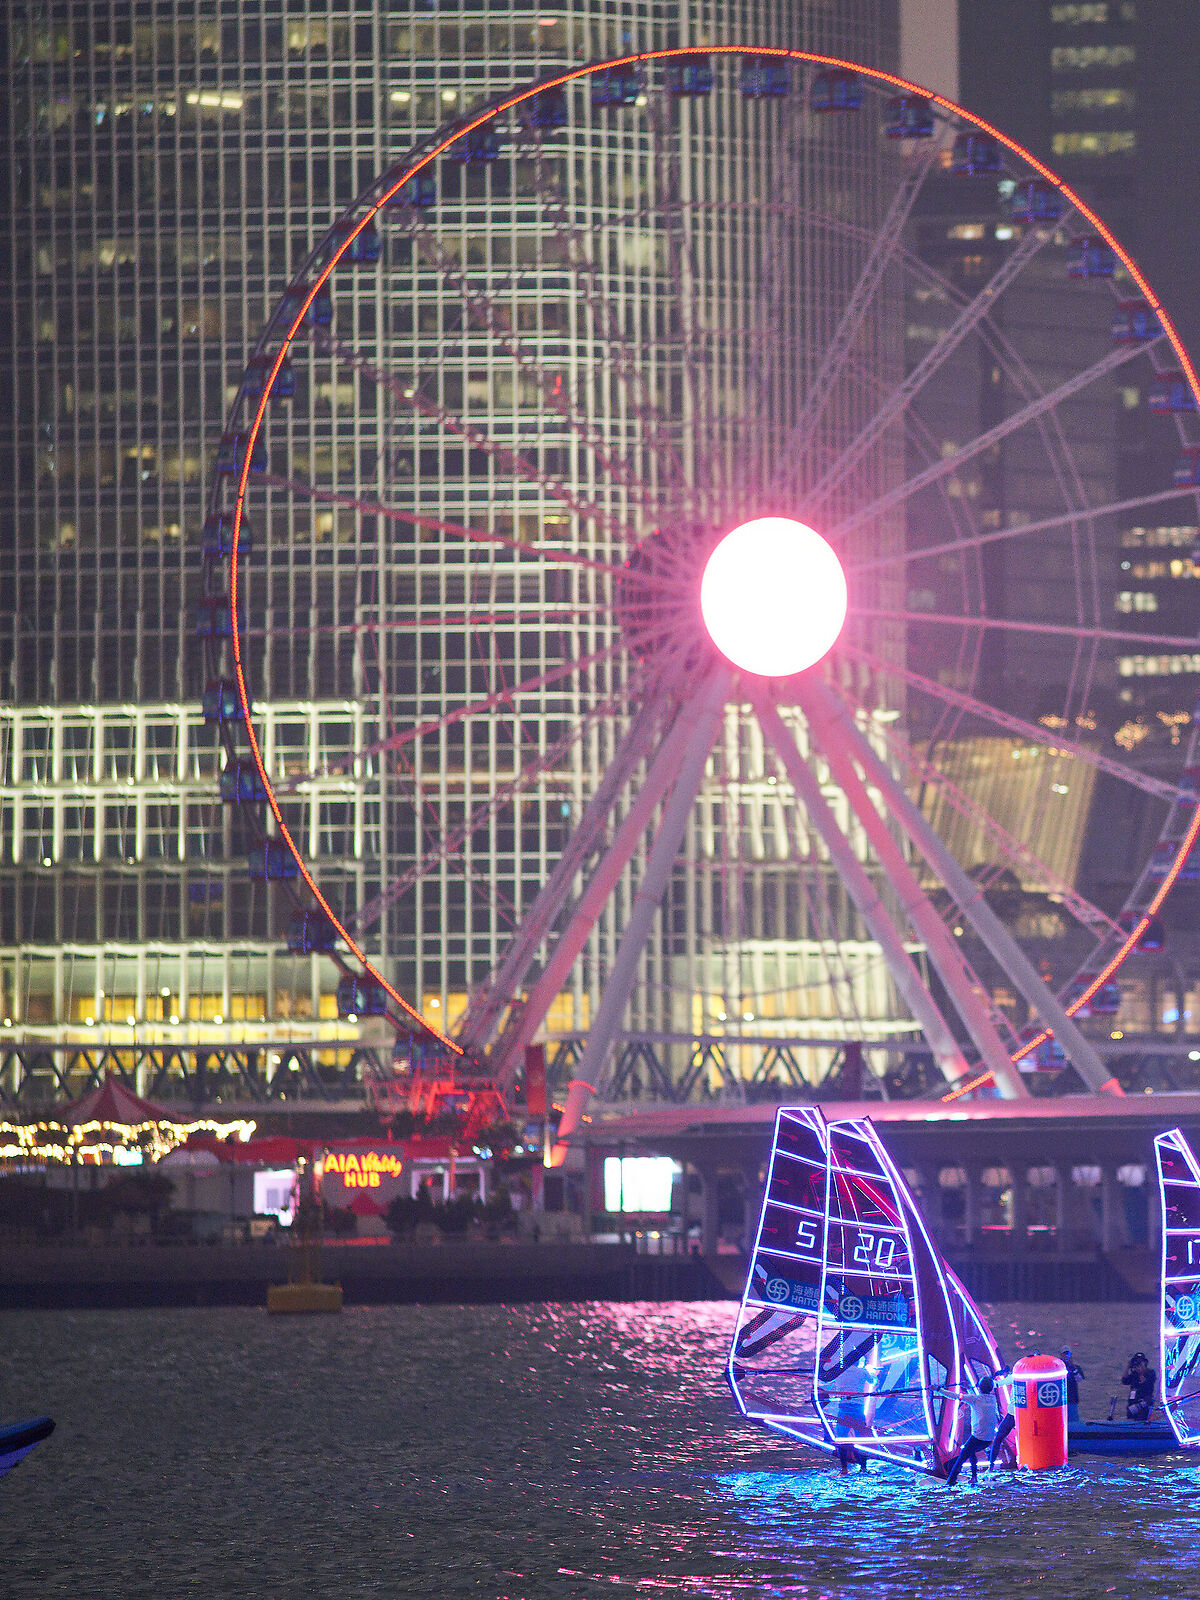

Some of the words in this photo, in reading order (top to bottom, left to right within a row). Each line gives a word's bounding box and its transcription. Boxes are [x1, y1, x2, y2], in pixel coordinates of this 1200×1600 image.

[325, 1153, 360, 1172] AIA
[344, 1171, 381, 1188] HUB
[796, 1221, 817, 1248] 5
[854, 1233, 895, 1267] 20
[791, 1295, 818, 1307] HAITO
[866, 1311, 907, 1322] HAITONG
